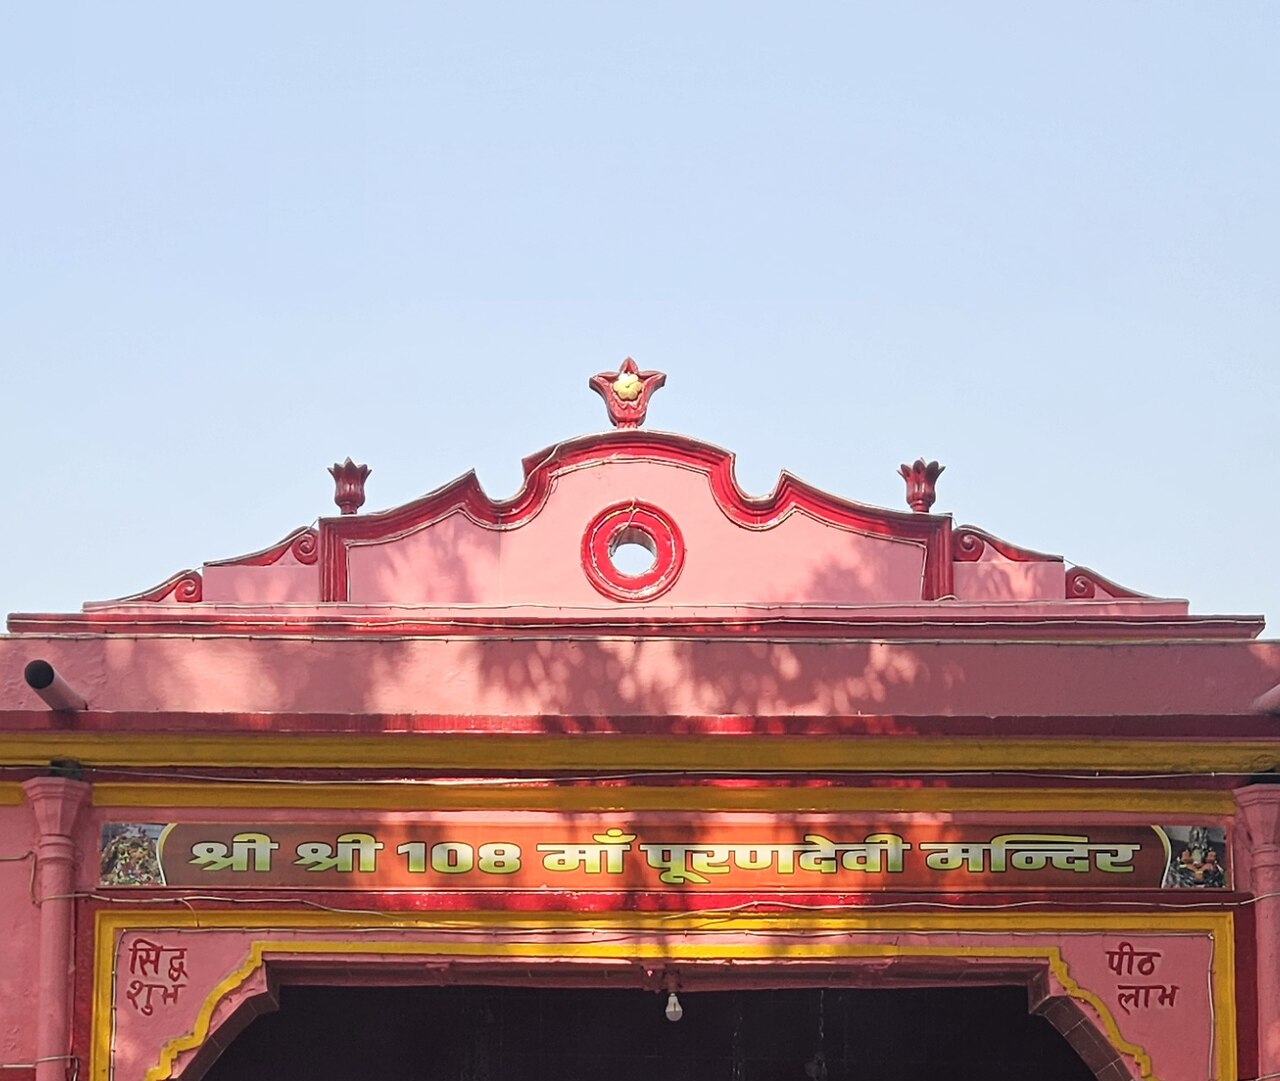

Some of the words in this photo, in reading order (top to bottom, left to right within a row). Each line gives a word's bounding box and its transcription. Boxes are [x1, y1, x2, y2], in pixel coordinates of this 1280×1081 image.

[188, 832, 280, 873] श्री
[293, 832, 385, 873] श्री
[396, 840, 523, 875] 108
[536, 828, 637, 874] माँ
[639, 833, 912, 884] पूरणदेवी
[919, 833, 1143, 874] मन्दिर
[1105, 941, 1162, 976] पीठ
[126, 980, 187, 1016] शुभ
[1117, 984, 1181, 1015] लाभ
